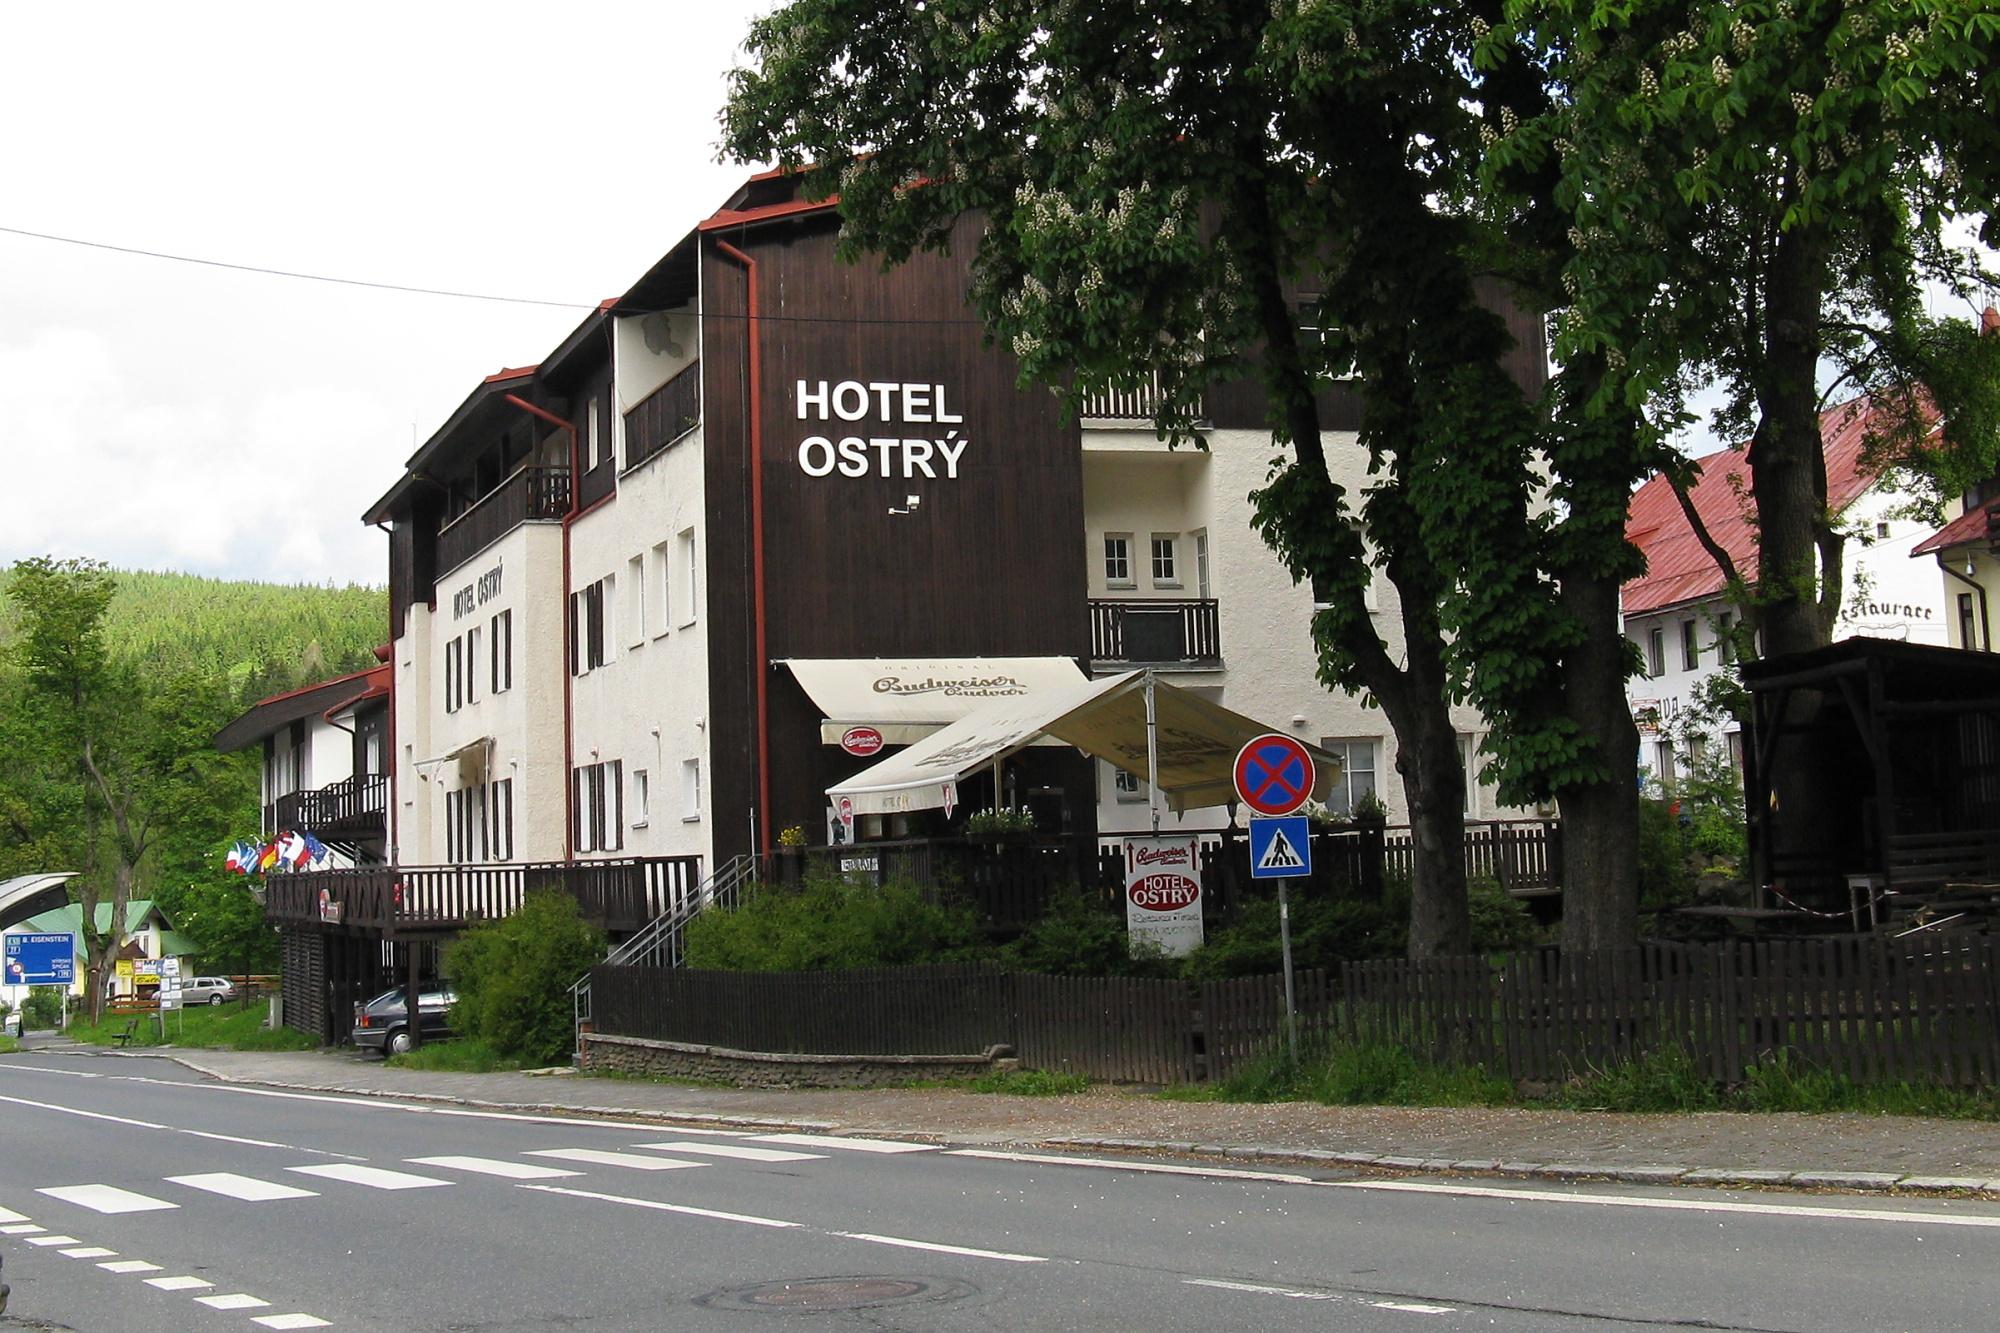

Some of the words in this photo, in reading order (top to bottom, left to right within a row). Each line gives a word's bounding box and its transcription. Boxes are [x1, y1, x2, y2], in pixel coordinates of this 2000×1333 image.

[797, 380, 963, 423] HOTEL
[798, 430, 969, 479] OSTRÝ
[453, 584, 475, 621] HOTEL
[478, 555, 503, 606] OSTRÝ
[873, 677, 1018, 695] Budweiser
[944, 686, 1028, 697] Budvar
[1144, 876, 1188, 890] HOTEL
